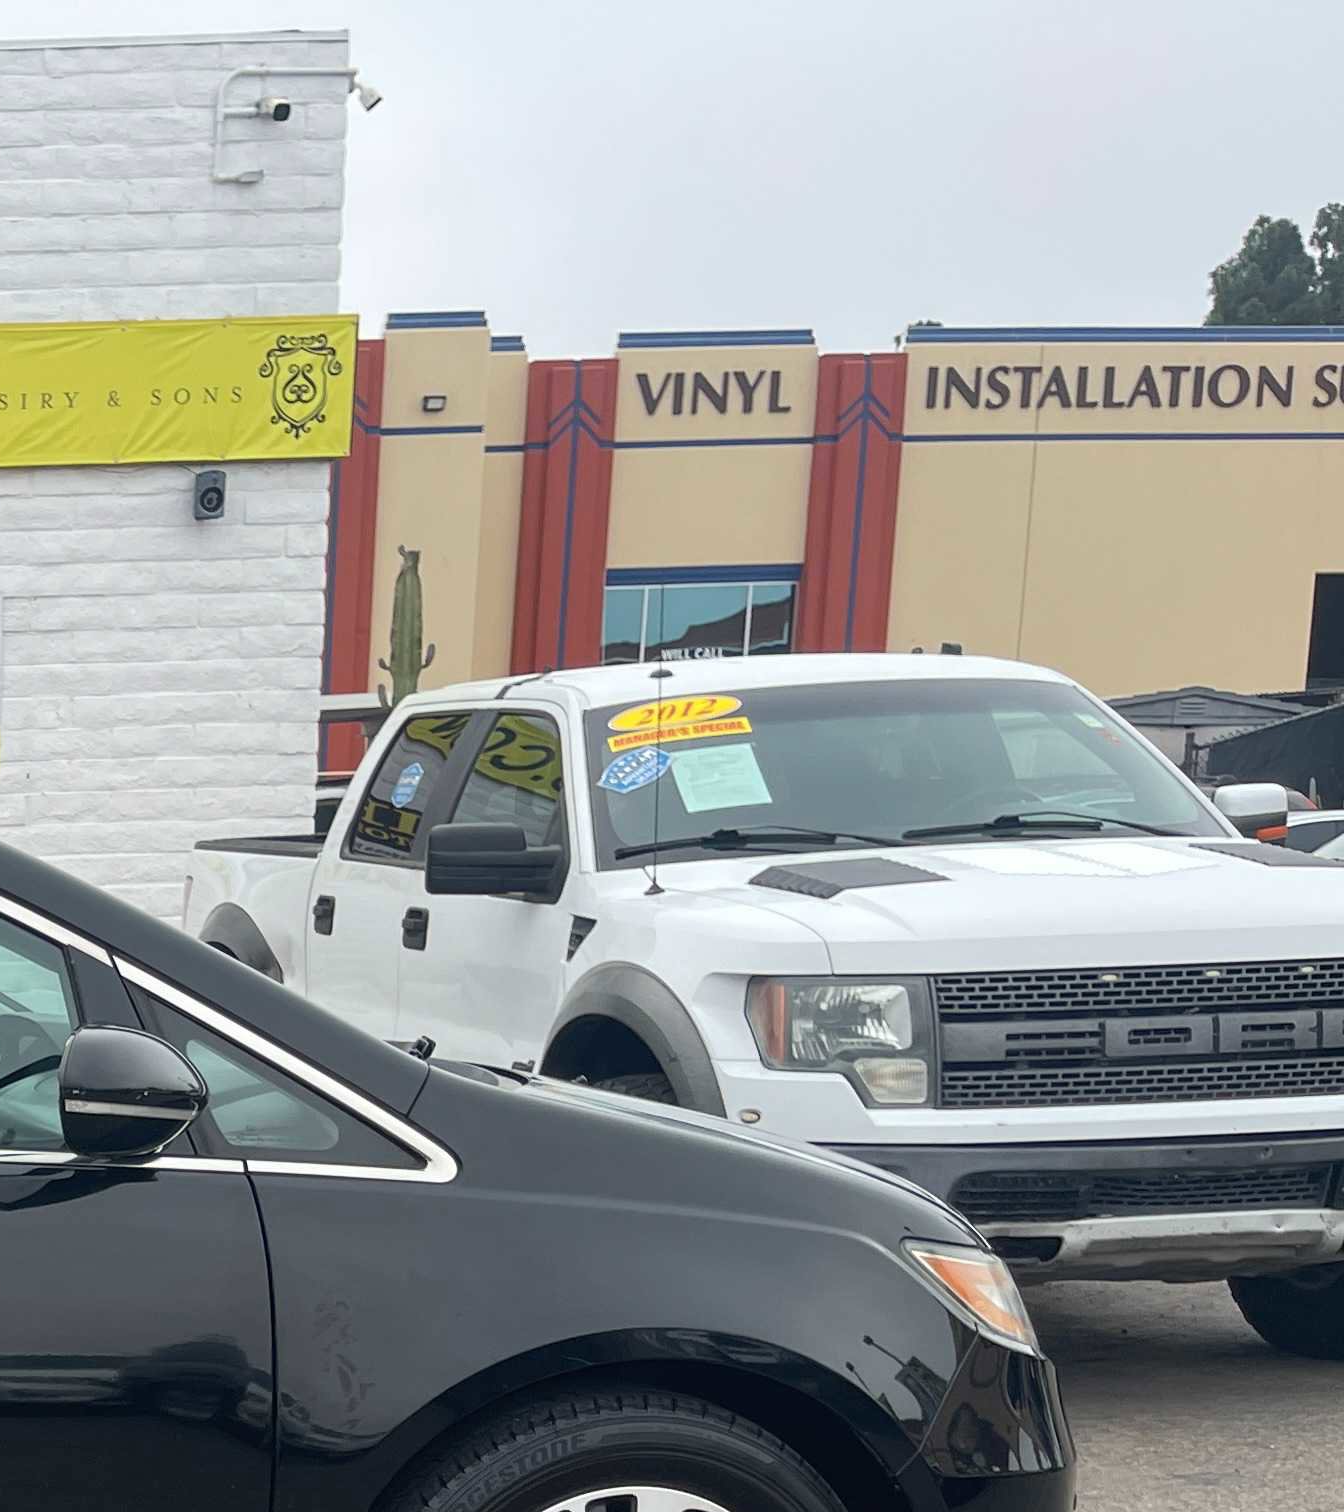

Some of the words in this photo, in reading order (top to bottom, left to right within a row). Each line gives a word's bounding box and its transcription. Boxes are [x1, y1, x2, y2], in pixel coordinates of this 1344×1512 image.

[106, 389, 123, 408] &
[150, 386, 244, 406] SONS
[636, 370, 791, 416] VINYL
[925, 364, 1294, 410] INSTALLATION
[1312, 364, 1344, 408] S
[637, 698, 718, 726] 2012
[941, 1008, 1344, 1062] FOR
